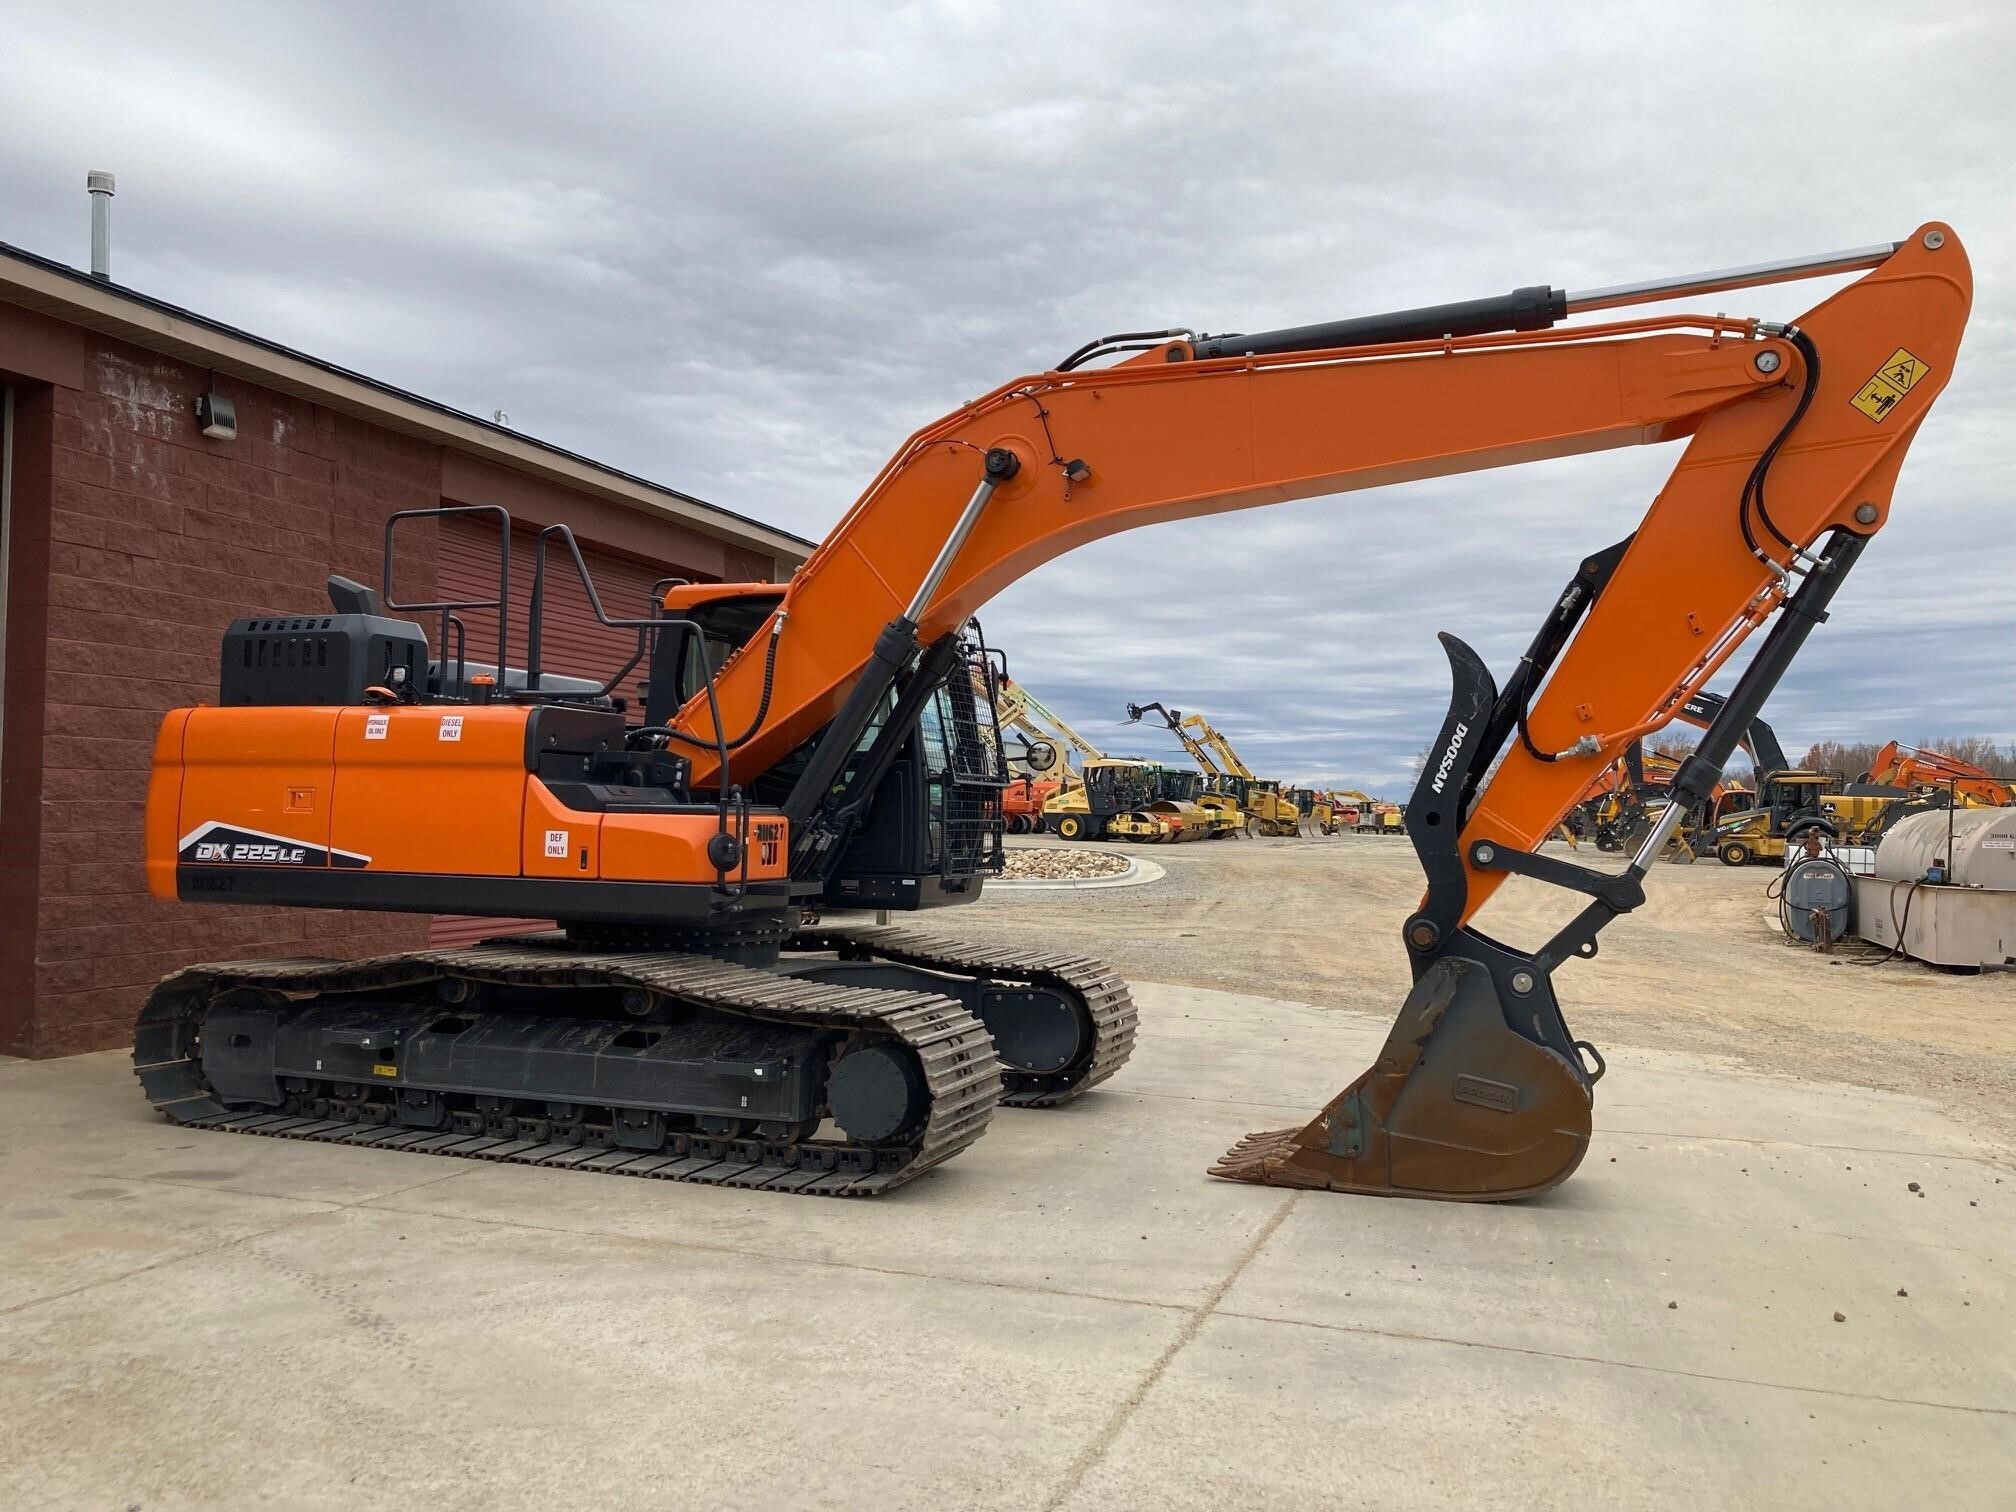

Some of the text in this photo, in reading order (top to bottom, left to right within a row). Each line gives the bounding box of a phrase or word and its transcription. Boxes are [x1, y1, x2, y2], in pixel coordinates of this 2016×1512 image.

[441, 718, 462, 727] DIESEL
[374, 727, 385, 735] ONLY
[442, 729, 458, 738] ONLY
[1431, 722, 1469, 794] DOOSAN
[550, 833, 564, 842] DEF
[196, 843, 230, 862] DX
[547, 845, 565, 855] ONLY
